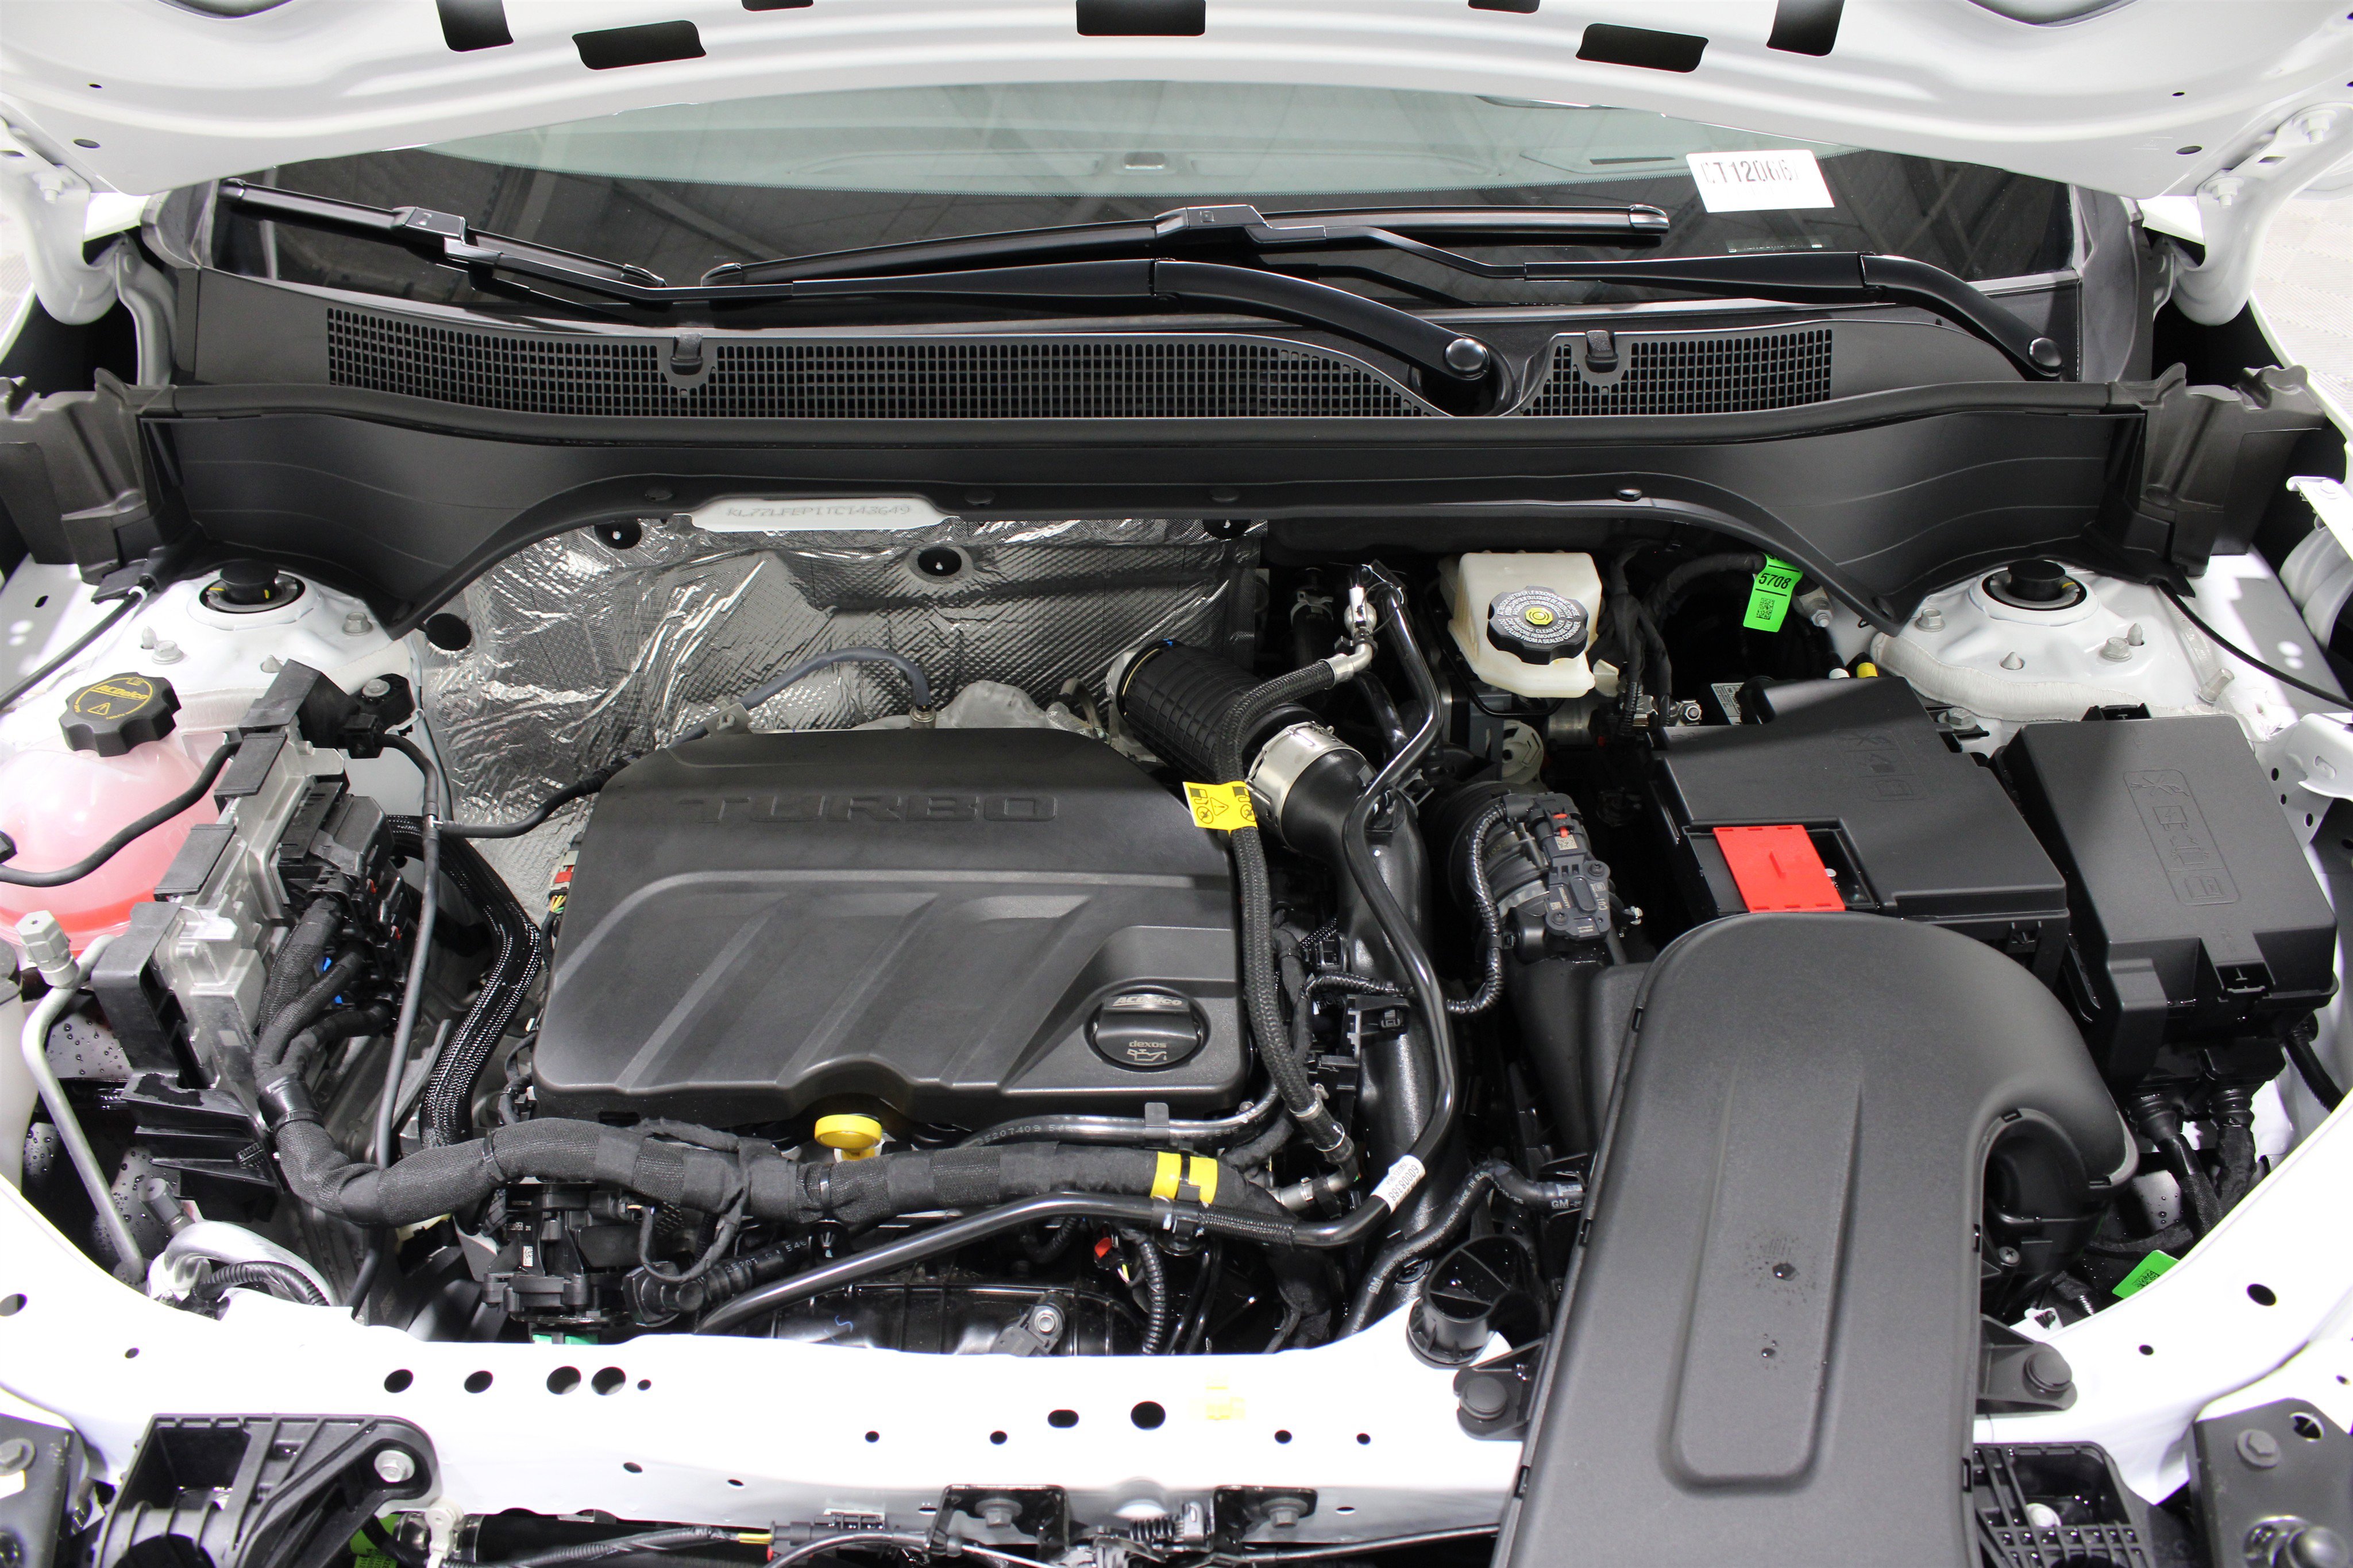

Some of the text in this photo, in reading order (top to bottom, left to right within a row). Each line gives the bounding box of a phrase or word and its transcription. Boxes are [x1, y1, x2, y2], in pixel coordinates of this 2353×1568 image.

[1758, 573, 1792, 589] 5708
[1506, 627, 1522, 638] FLUID
[1521, 635, 1538, 643] FROM
[1562, 621, 1581, 640] CONTAINER
[1511, 625, 1532, 636] BEFORE
[1563, 620, 1573, 630] ONLY
[1552, 619, 1565, 631] FILLER
[95, 684, 149, 700] ACDelco
[677, 794, 1058, 823] TURBO
[1113, 996, 1183, 1006] ACDelco
[1129, 1040, 1167, 1048] dexos
[1390, 1164, 1419, 1202] 60008388
[1457, 1188, 1471, 1207] MADE
